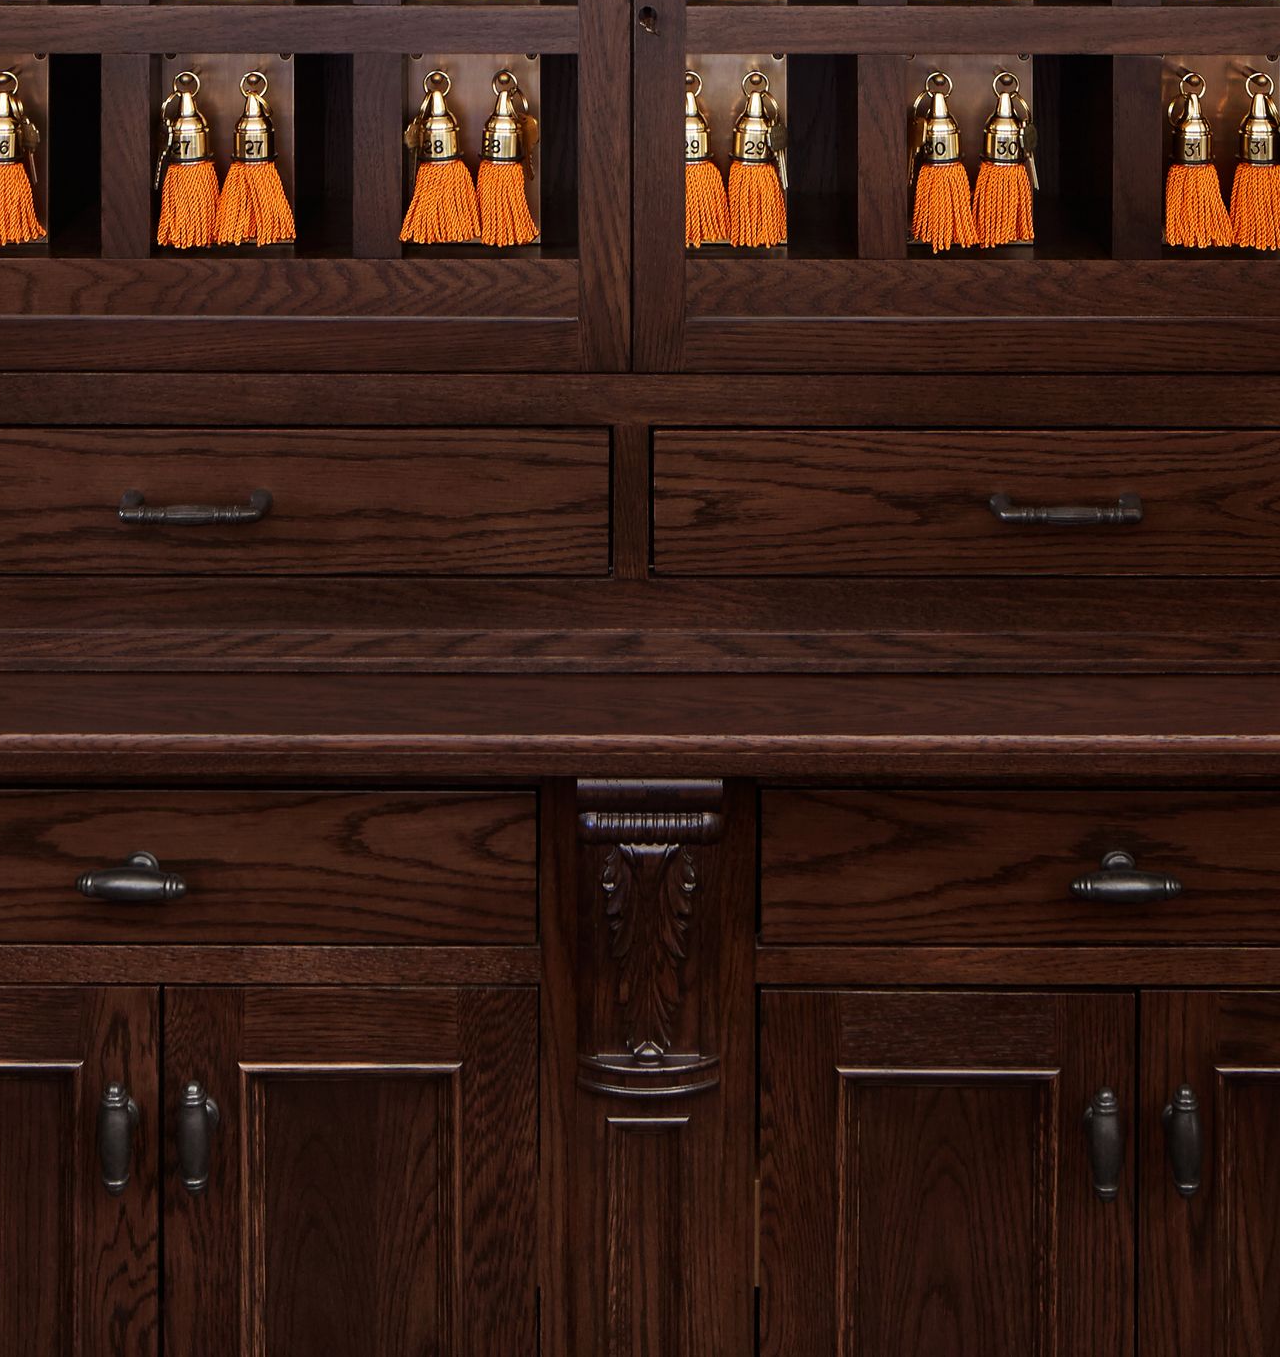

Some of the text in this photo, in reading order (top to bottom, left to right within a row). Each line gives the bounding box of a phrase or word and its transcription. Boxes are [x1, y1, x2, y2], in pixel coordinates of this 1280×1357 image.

[173, 140, 191, 155] 27
[245, 140, 264, 155] 27
[423, 139, 444, 154] 28
[483, 139, 501, 154] 28
[744, 141, 765, 155] 29
[996, 141, 1017, 156] 30
[1184, 142, 1201, 157] 31
[1250, 140, 1267, 155] 31
